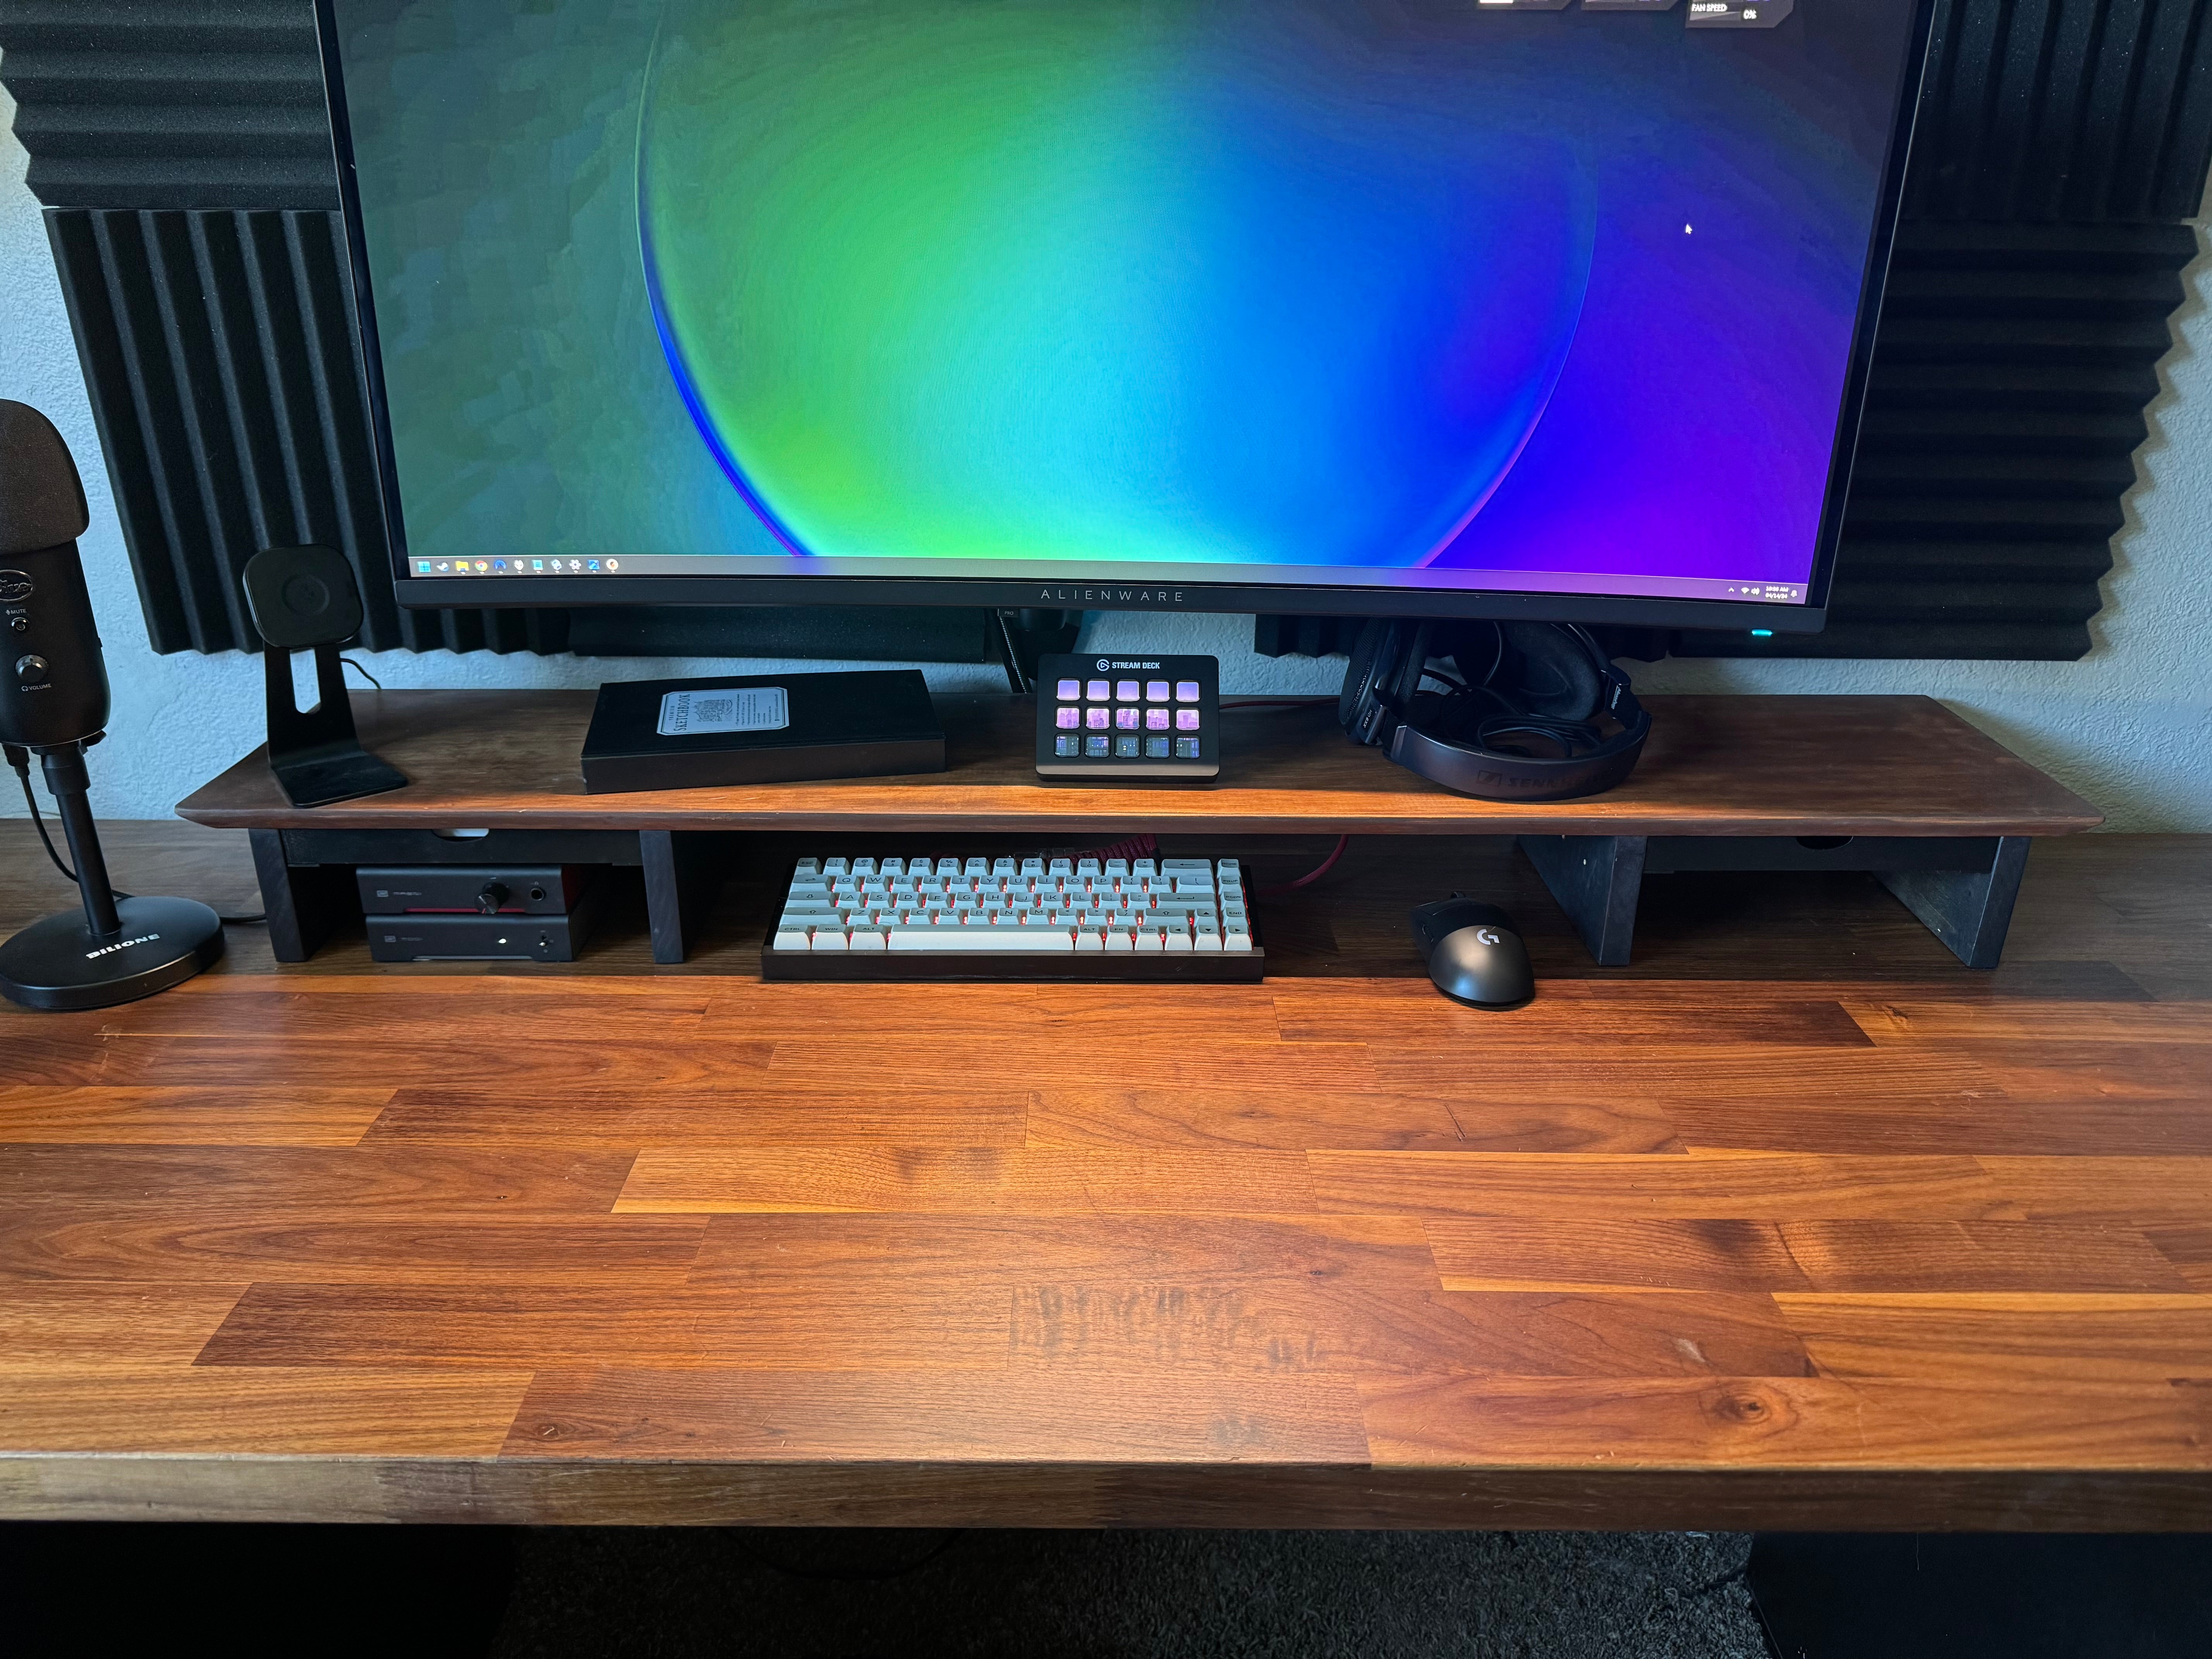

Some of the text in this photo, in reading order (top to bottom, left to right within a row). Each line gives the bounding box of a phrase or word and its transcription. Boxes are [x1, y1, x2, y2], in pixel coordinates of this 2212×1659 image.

[1691, 3, 1728, 12] FAN SPEED
[1743, 9, 1757, 19] 0%
[1041, 589, 1183, 601] ALIENWARE
[673, 694, 690, 731] SKETCHBOOK
[1367, 709, 1372, 717] HD
[86, 934, 160, 959] BILIONE
